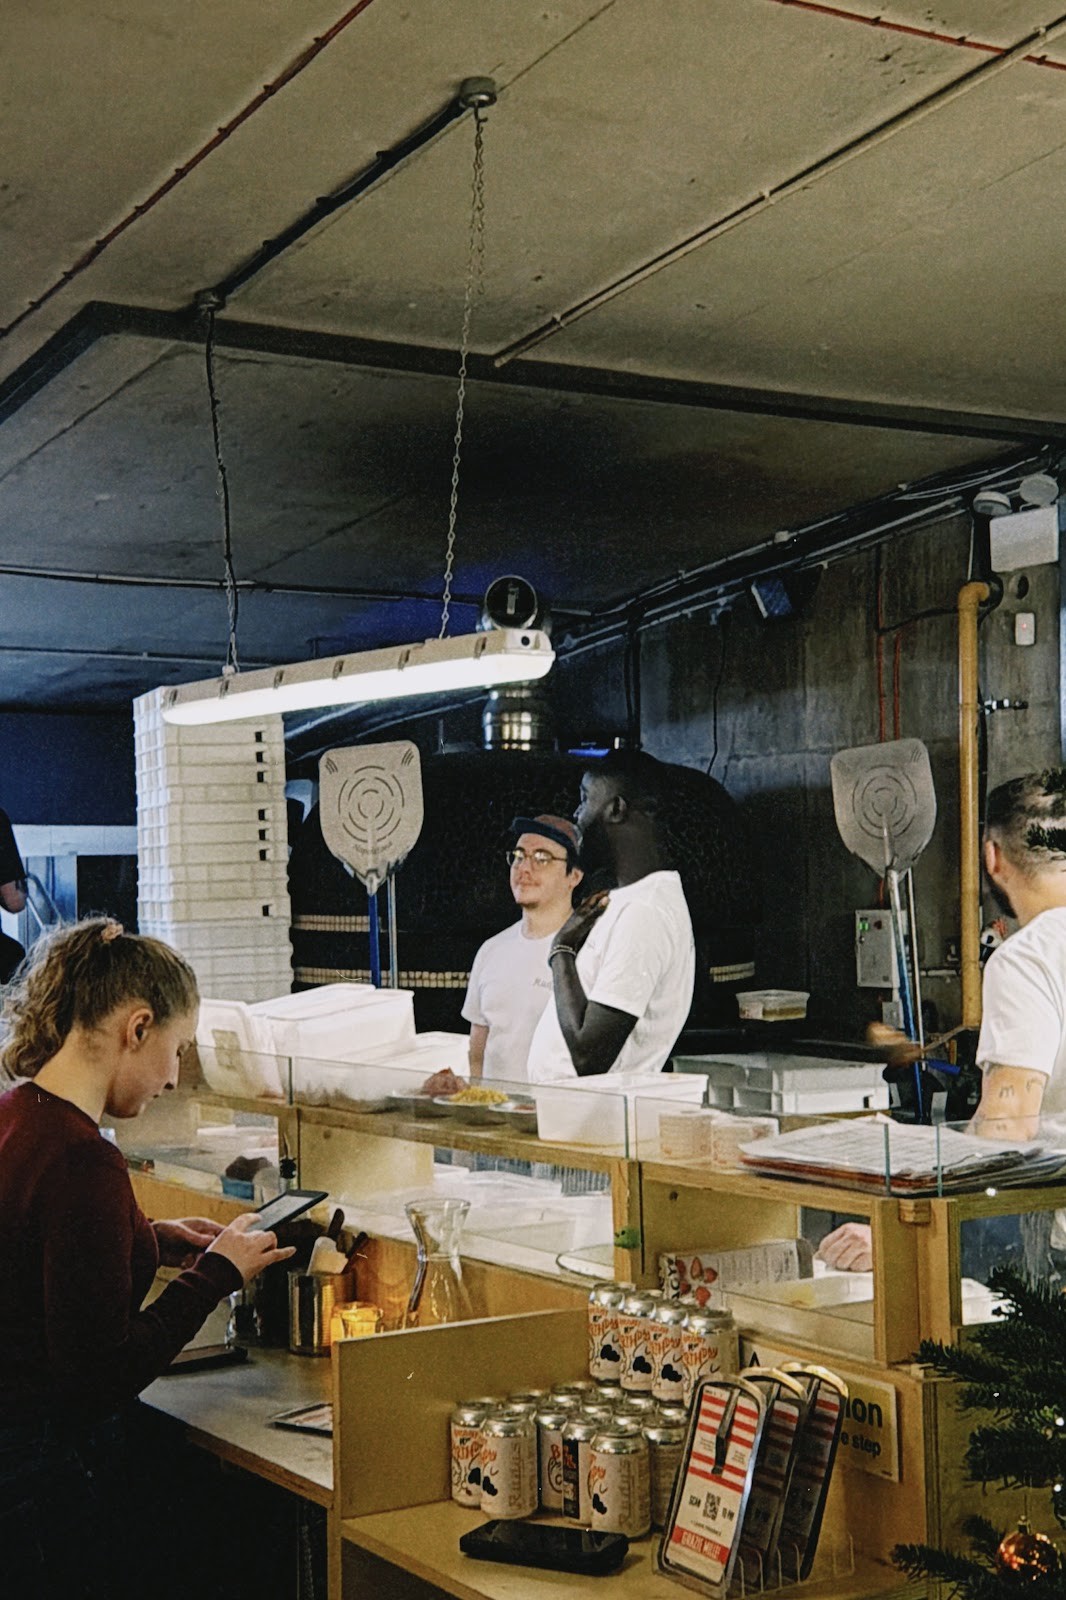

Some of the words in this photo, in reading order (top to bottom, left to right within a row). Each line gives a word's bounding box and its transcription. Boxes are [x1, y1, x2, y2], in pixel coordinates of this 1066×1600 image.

[852, 1433, 882, 1459] step
[688, 1494, 701, 1508] SCAN
[680, 1530, 704, 1553] GRAZIE
